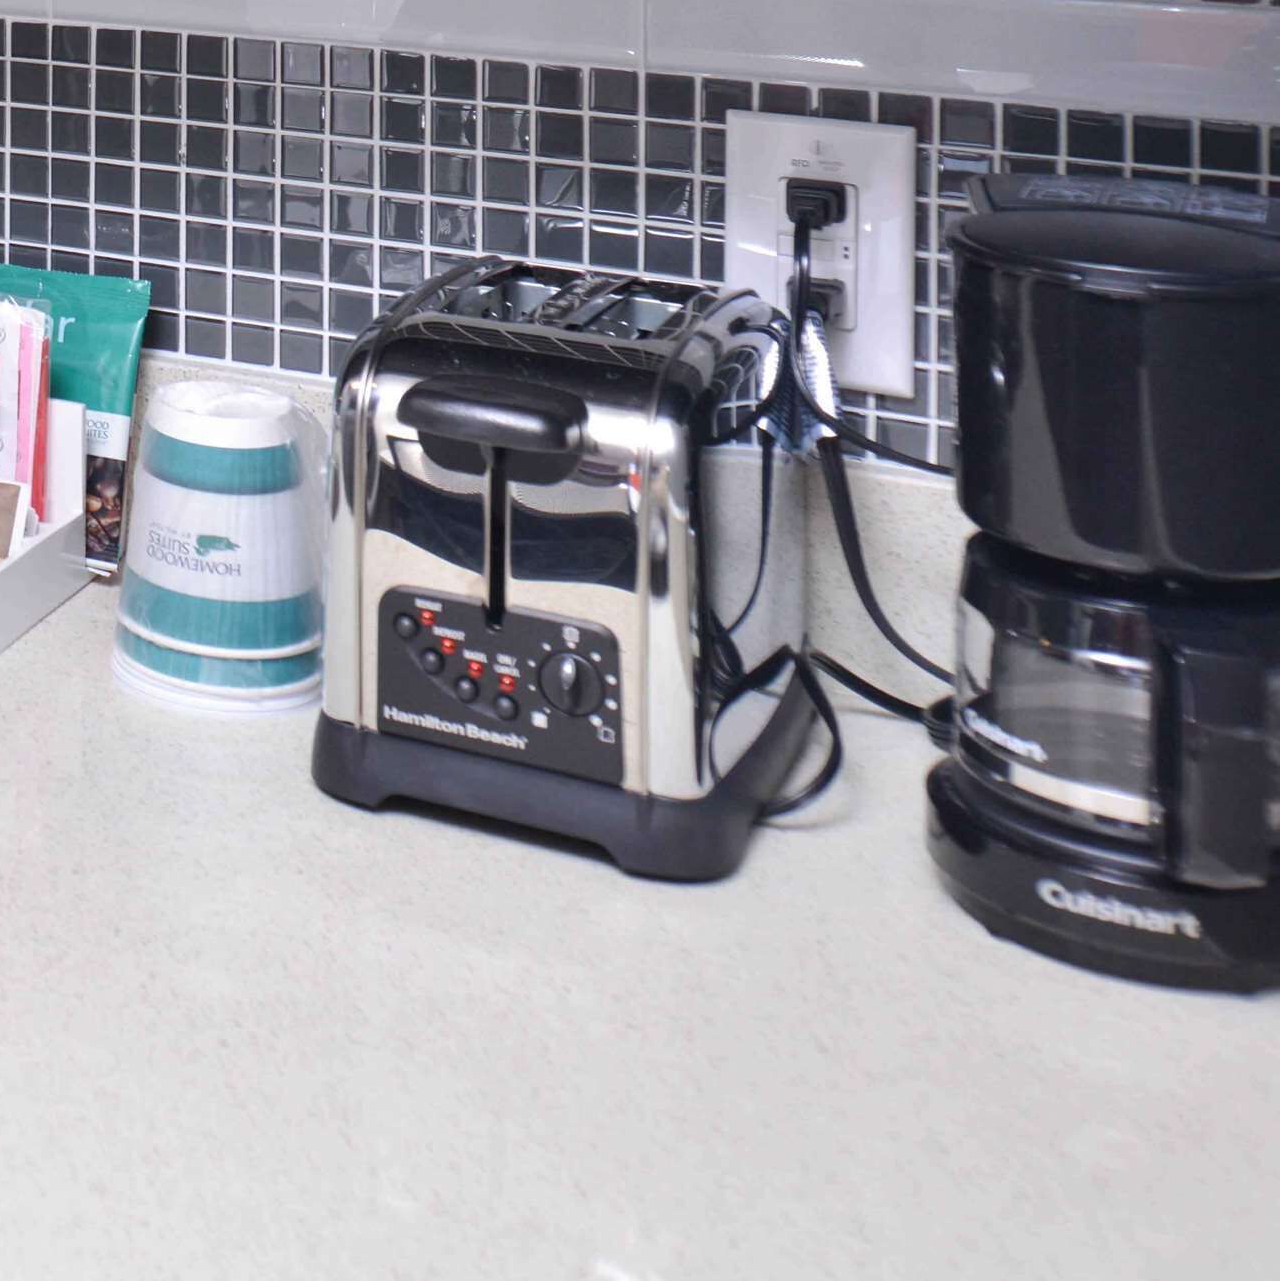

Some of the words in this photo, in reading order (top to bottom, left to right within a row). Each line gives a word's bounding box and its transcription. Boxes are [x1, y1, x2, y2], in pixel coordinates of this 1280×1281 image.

[146, 544, 241, 576] HOMEWOOD
[147, 529, 190, 555] SUITES
[383, 704, 465, 736] Hamilton
[465, 722, 527, 750] Beach
[1036, 878, 1201, 939] Cuisinart
